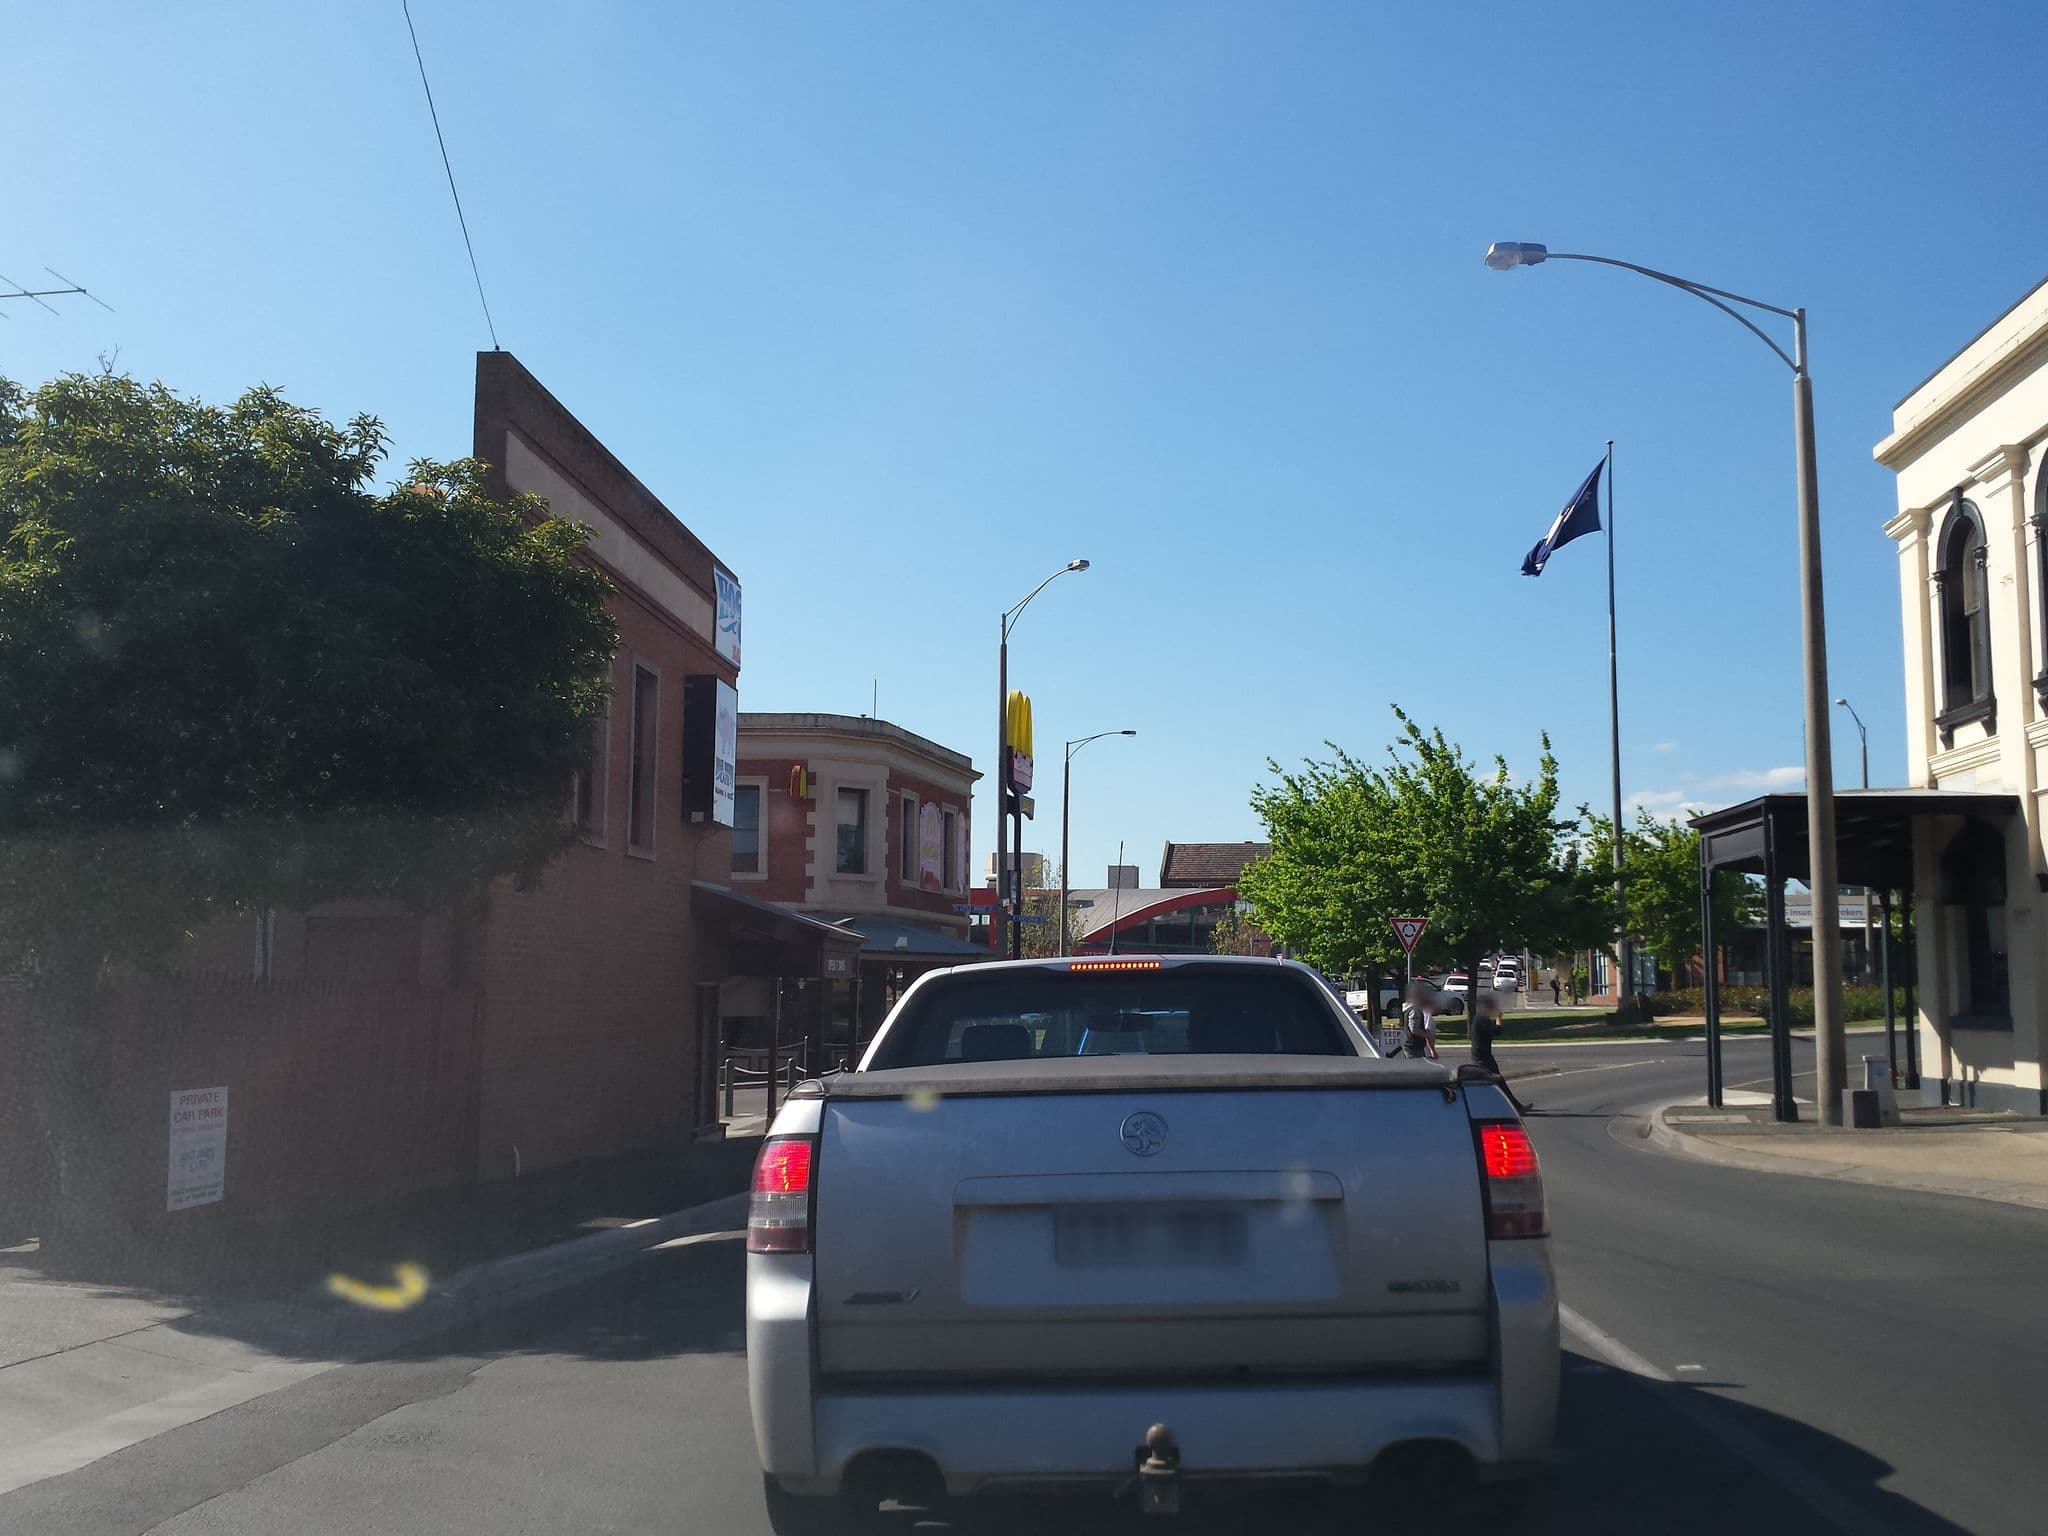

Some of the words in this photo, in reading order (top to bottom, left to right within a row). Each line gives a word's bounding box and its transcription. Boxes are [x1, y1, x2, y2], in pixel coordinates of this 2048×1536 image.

[1383, 1030, 1401, 1038] KEEP
[180, 1092, 220, 1106] PRIVATE
[174, 1110, 195, 1123] CAR
[198, 1107, 224, 1121] PARK
